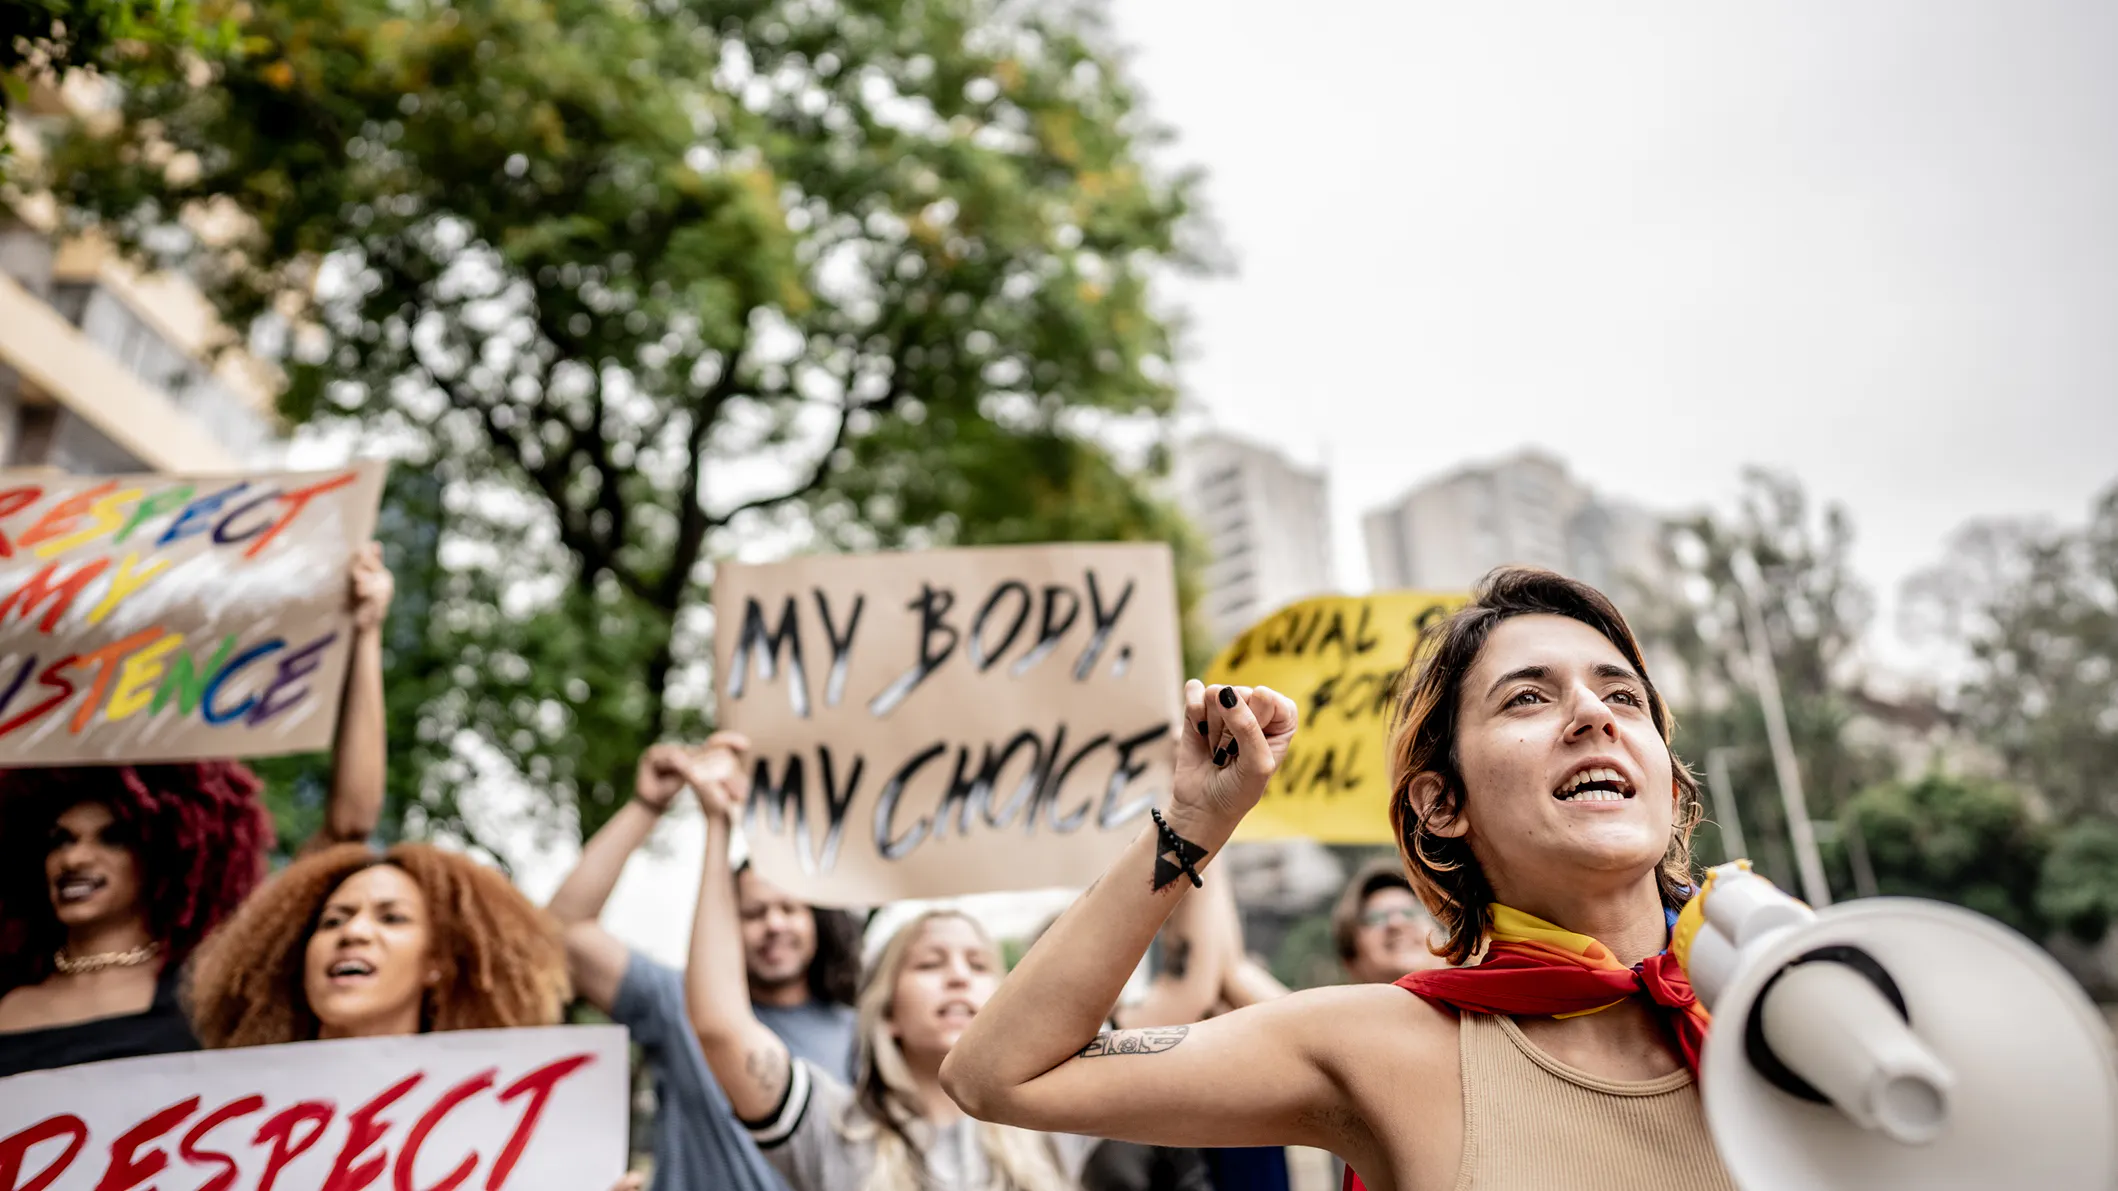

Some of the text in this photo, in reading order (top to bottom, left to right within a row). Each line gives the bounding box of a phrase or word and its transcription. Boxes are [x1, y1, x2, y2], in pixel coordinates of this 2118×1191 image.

[0, 553, 171, 635] MY
[728, 569, 1135, 718] MY BODY.
[743, 722, 1170, 876] MY CHOICE
